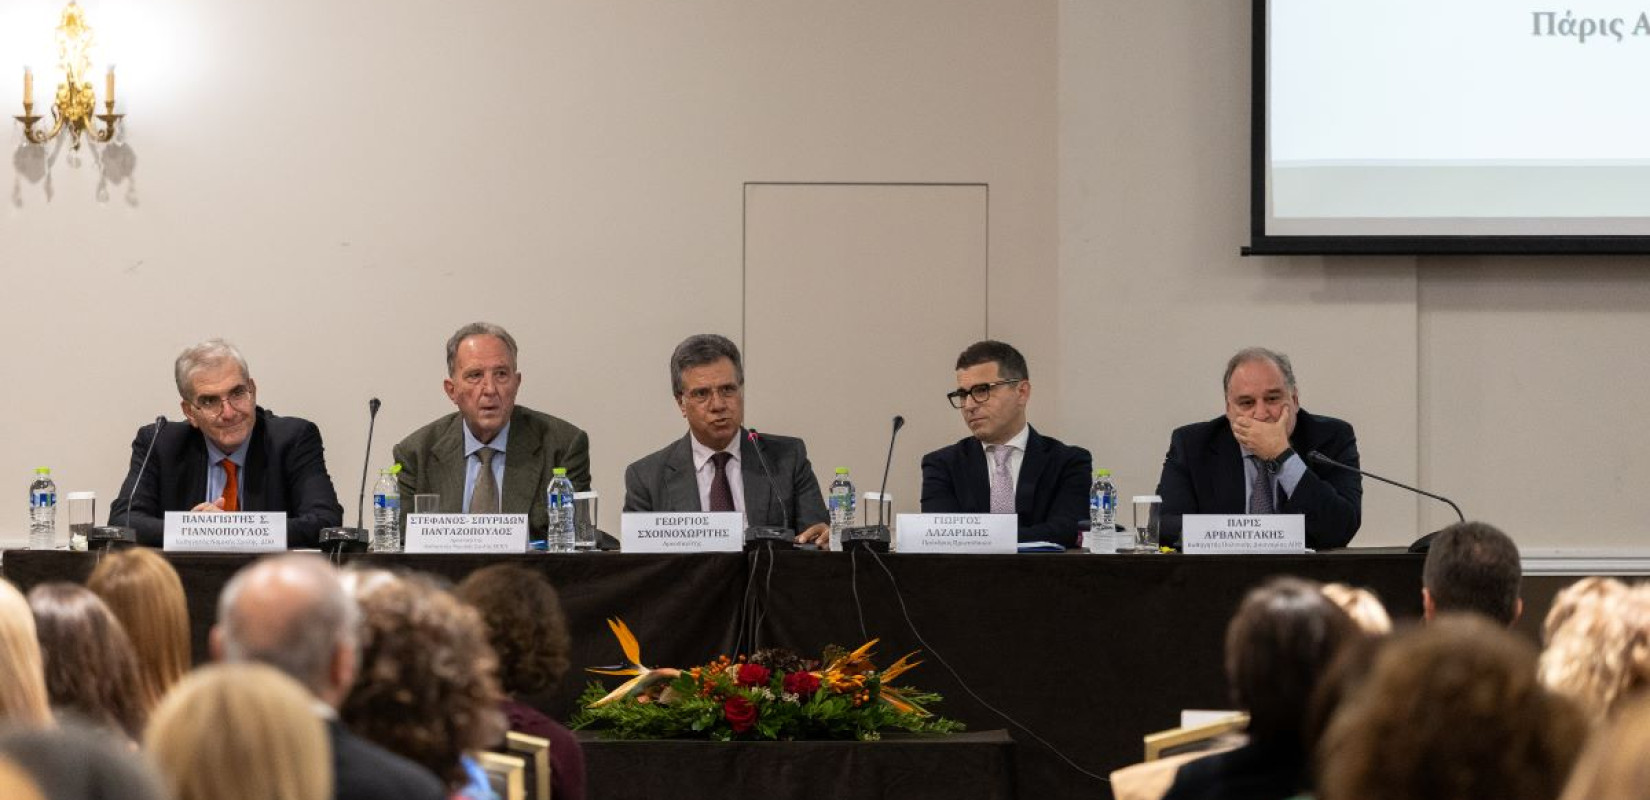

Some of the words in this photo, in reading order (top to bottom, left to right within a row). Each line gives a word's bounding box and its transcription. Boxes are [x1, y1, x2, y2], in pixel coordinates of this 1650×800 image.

[1531, 9, 1624, 43] Πάρις
[182, 515, 255, 524] ΠΑΝΑΓΙΩΤΗΣ
[472, 516, 525, 525] ΣΠΥΡΙΔΩΝ
[655, 516, 710, 526] ΓΕΩΡΓΙΟΣ
[934, 516, 982, 525] ΓΙΩΡΓΟΣ
[1227, 518, 1262, 527] ΠΑΡΙΣ
[181, 527, 270, 537] ΓΙΑΝΝΟΠΟΥΛΟΣ
[421, 527, 513, 536] ΠΑΝΤΑΖΟΠΟΥΛΟΣ
[637, 528, 730, 539] ΣΧΟΙΝΟΧΩΡΙΤΗΣ
[925, 528, 990, 537] ΛΑΖΑΡΙΔΗΣ
[1204, 530, 1285, 540] ΑΡΒΑΝΙΤΑΚΗΣ
